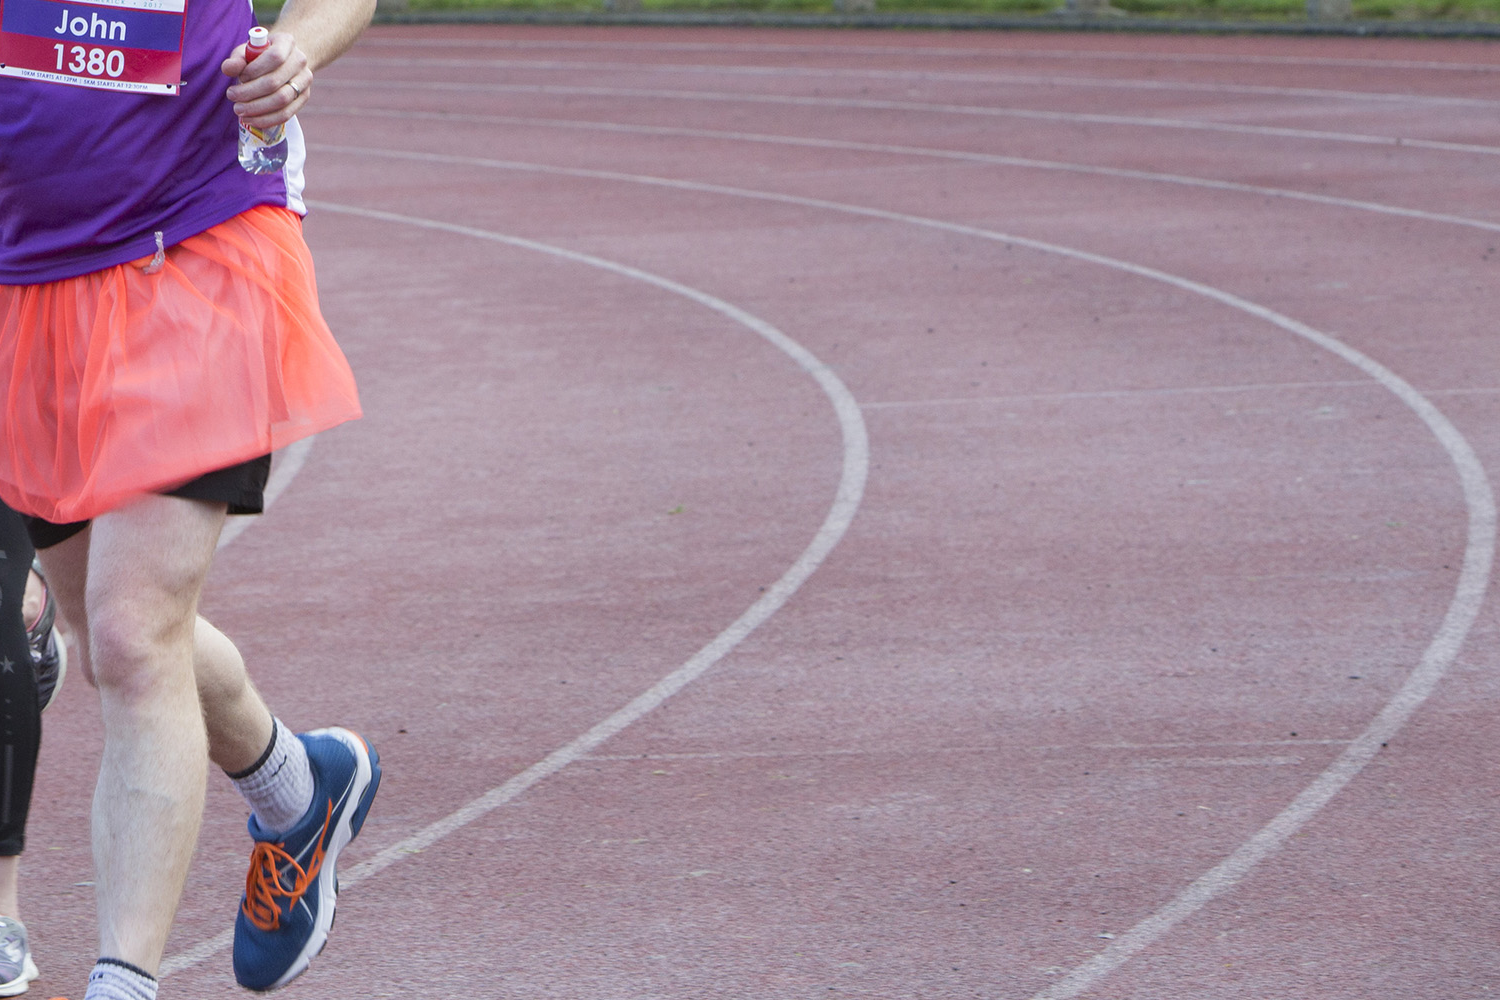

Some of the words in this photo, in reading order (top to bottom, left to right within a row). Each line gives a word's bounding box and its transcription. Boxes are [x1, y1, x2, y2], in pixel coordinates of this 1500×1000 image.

[54, 9, 127, 41] John
[53, 43, 125, 78] 1380
[21, 70, 36, 78] 10KM
[36, 72, 55, 80] STARTS
[63, 75, 78, 83] 12PM
[97, 80, 116, 88] STARTS
